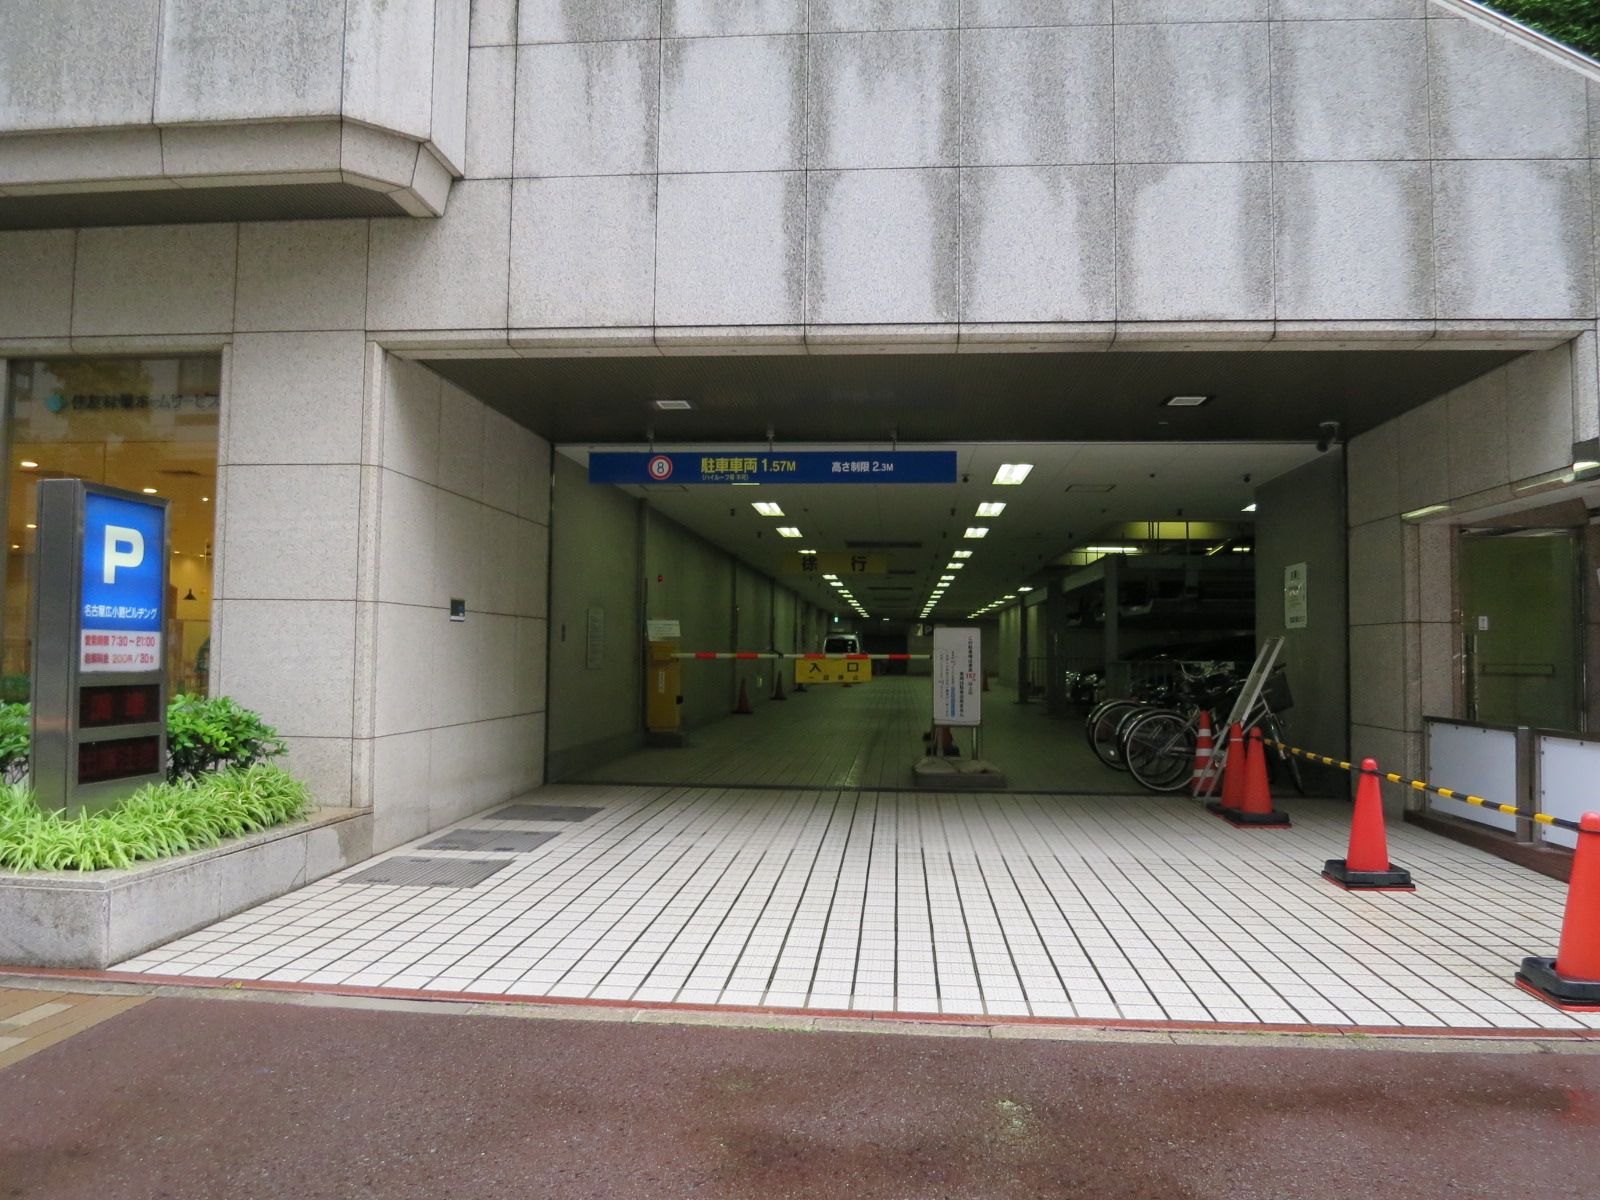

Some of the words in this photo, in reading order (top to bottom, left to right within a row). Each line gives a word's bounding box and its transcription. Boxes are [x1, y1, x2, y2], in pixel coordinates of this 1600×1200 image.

[656, 461, 666, 475] 8
[701, 457, 757, 473] 駐車車両
[761, 459, 796, 472] 1.57M
[831, 461, 870, 473] 高さ制限
[872, 461, 894, 472] 2.3M
[103, 524, 144, 584] P
